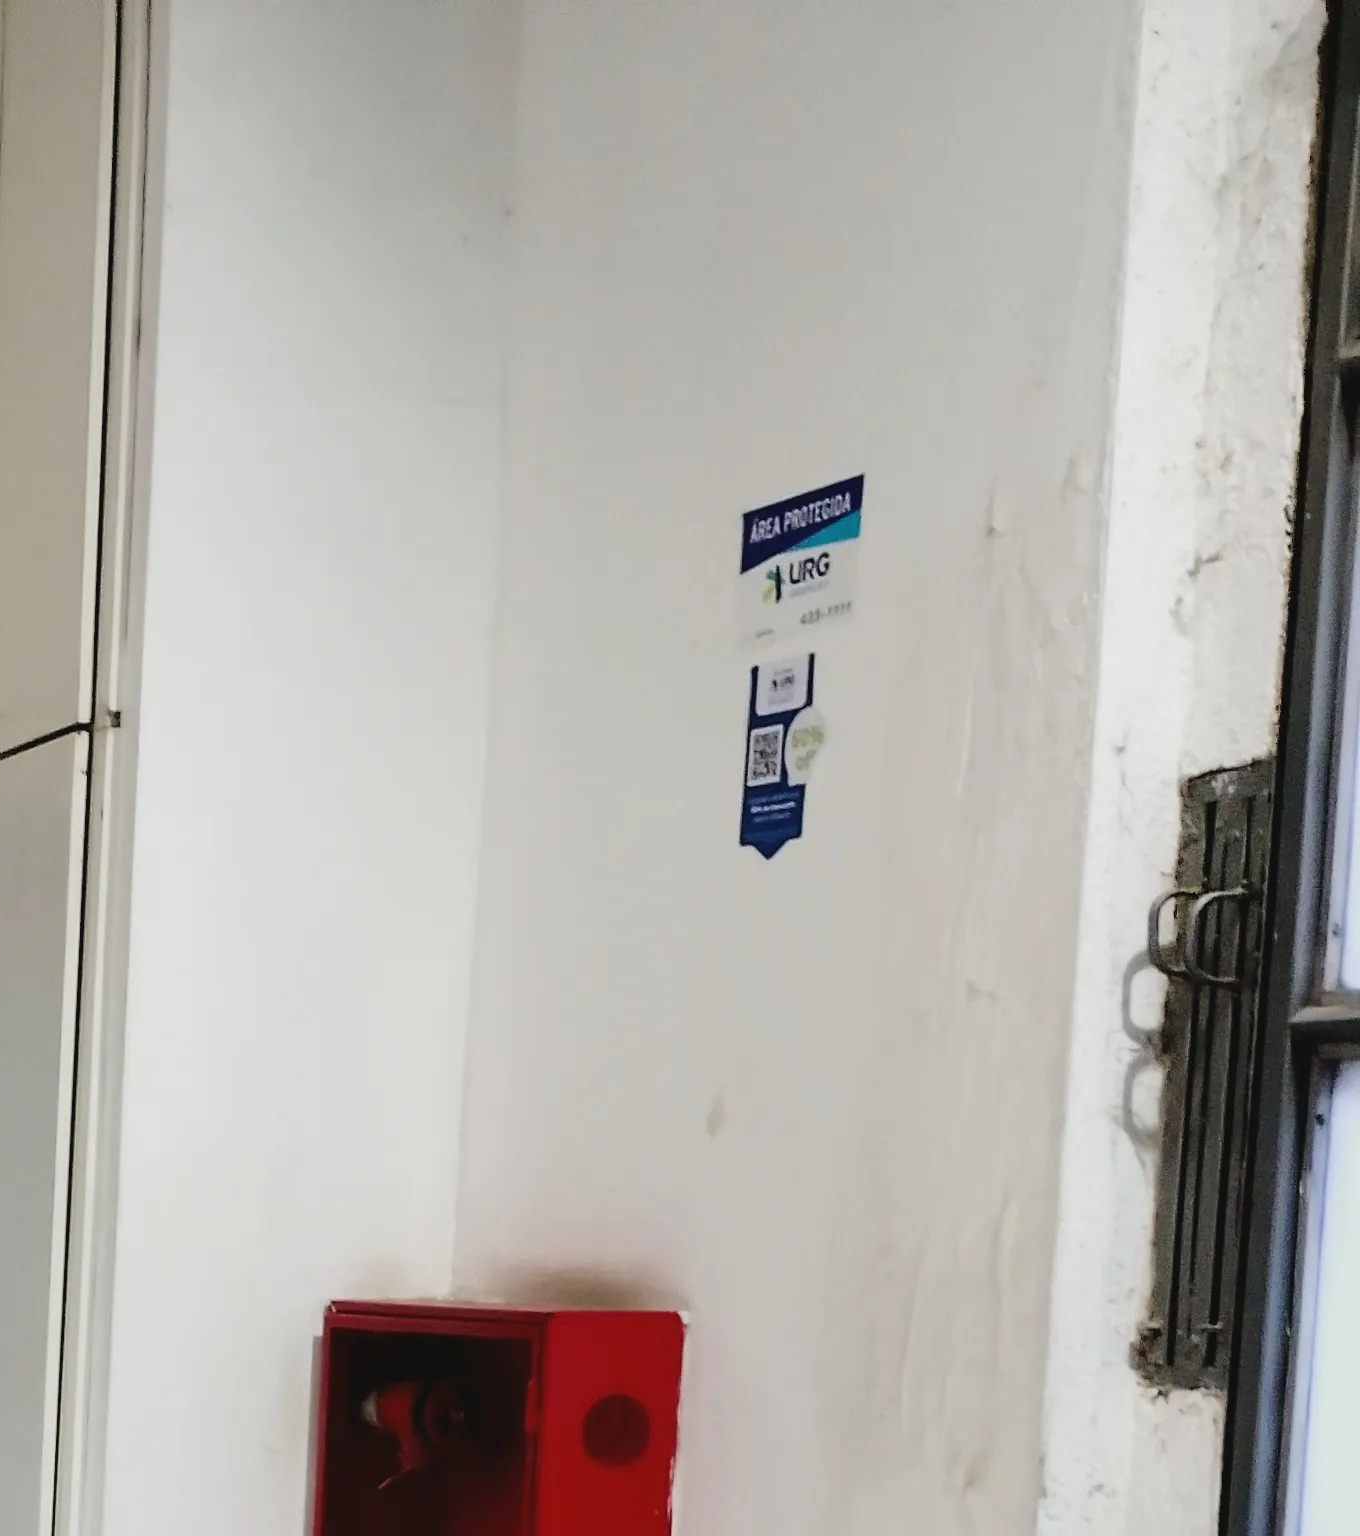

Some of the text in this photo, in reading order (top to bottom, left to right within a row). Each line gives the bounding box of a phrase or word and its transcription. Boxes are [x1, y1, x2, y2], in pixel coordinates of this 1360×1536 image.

[749, 492, 851, 544] ÁREA PROTEGIDA
[789, 552, 830, 584] URG
